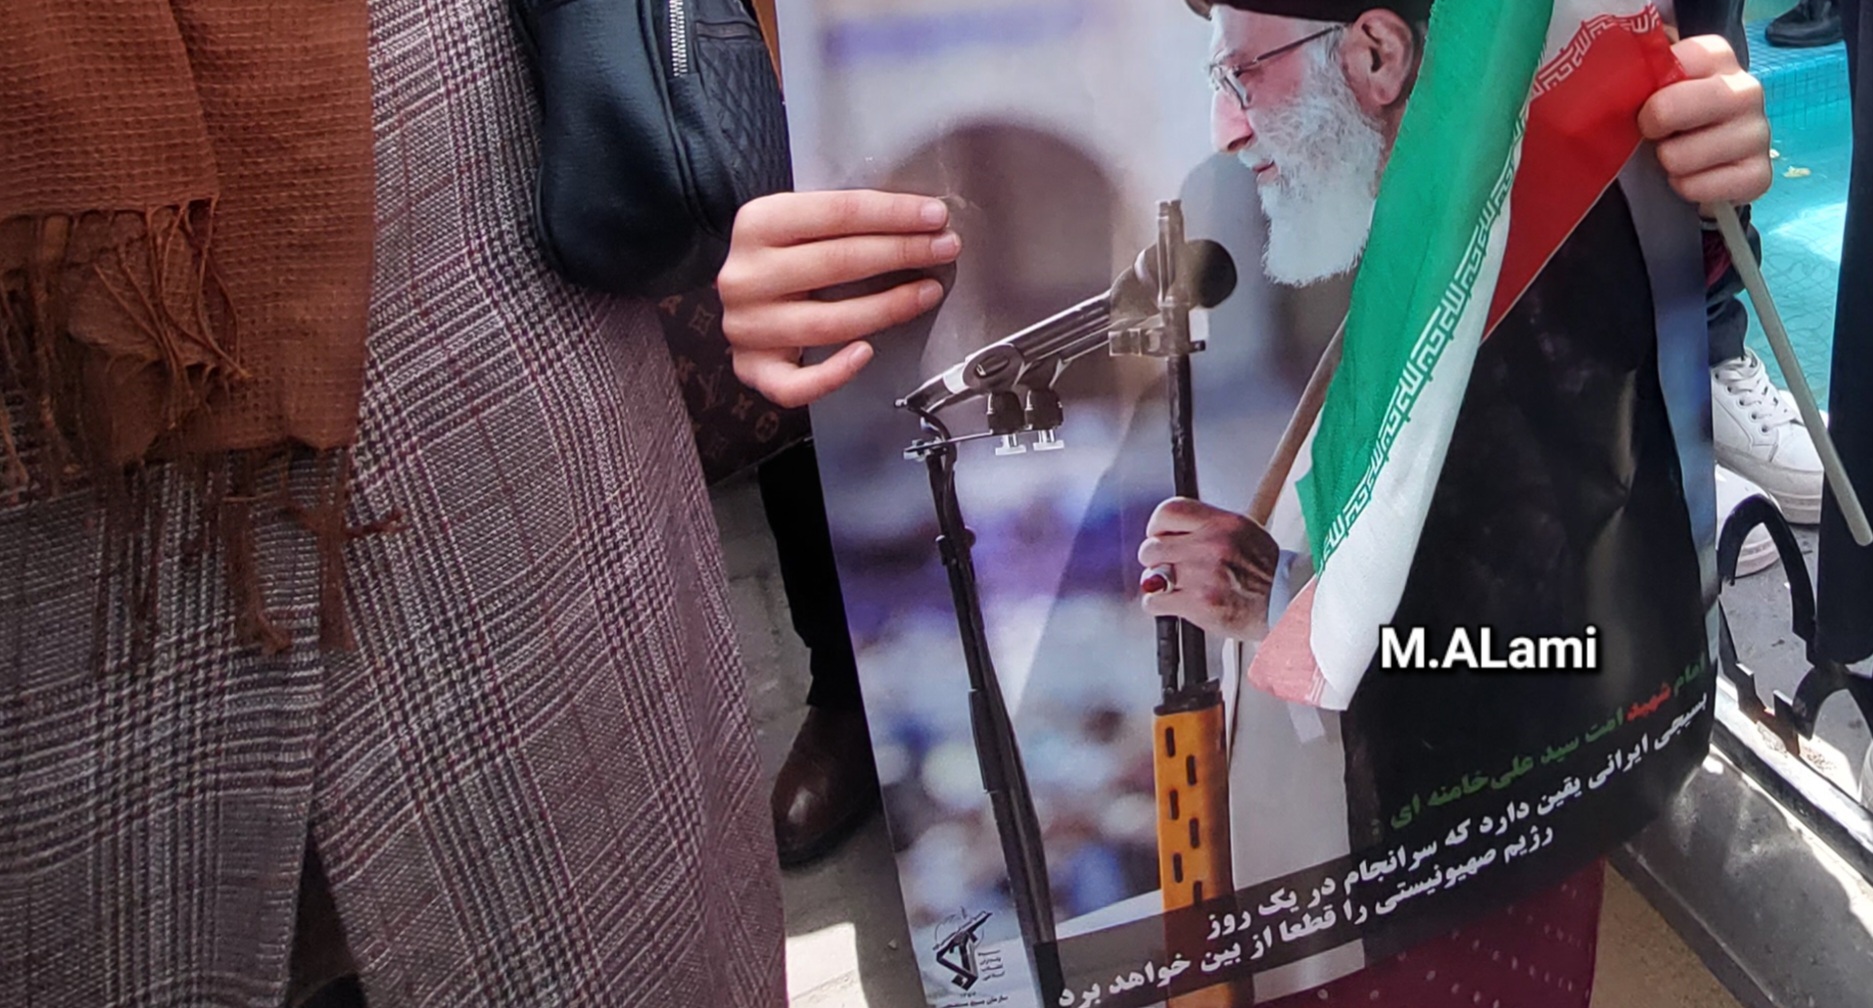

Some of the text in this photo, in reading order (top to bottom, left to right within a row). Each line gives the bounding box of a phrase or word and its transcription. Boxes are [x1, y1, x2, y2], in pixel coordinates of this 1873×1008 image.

[1674, 652, 1706, 697] امام
[1625, 681, 1672, 722] شهید
[1585, 706, 1624, 743] امت
[1540, 735, 1580, 765] سید
[1206, 692, 1708, 941] بسیجی ایرانی یقین دارد که سرانجام در یک روز
[1058, 825, 1554, 1008] رژیم صهیونیستی را قطعا از بین خواهد برد
